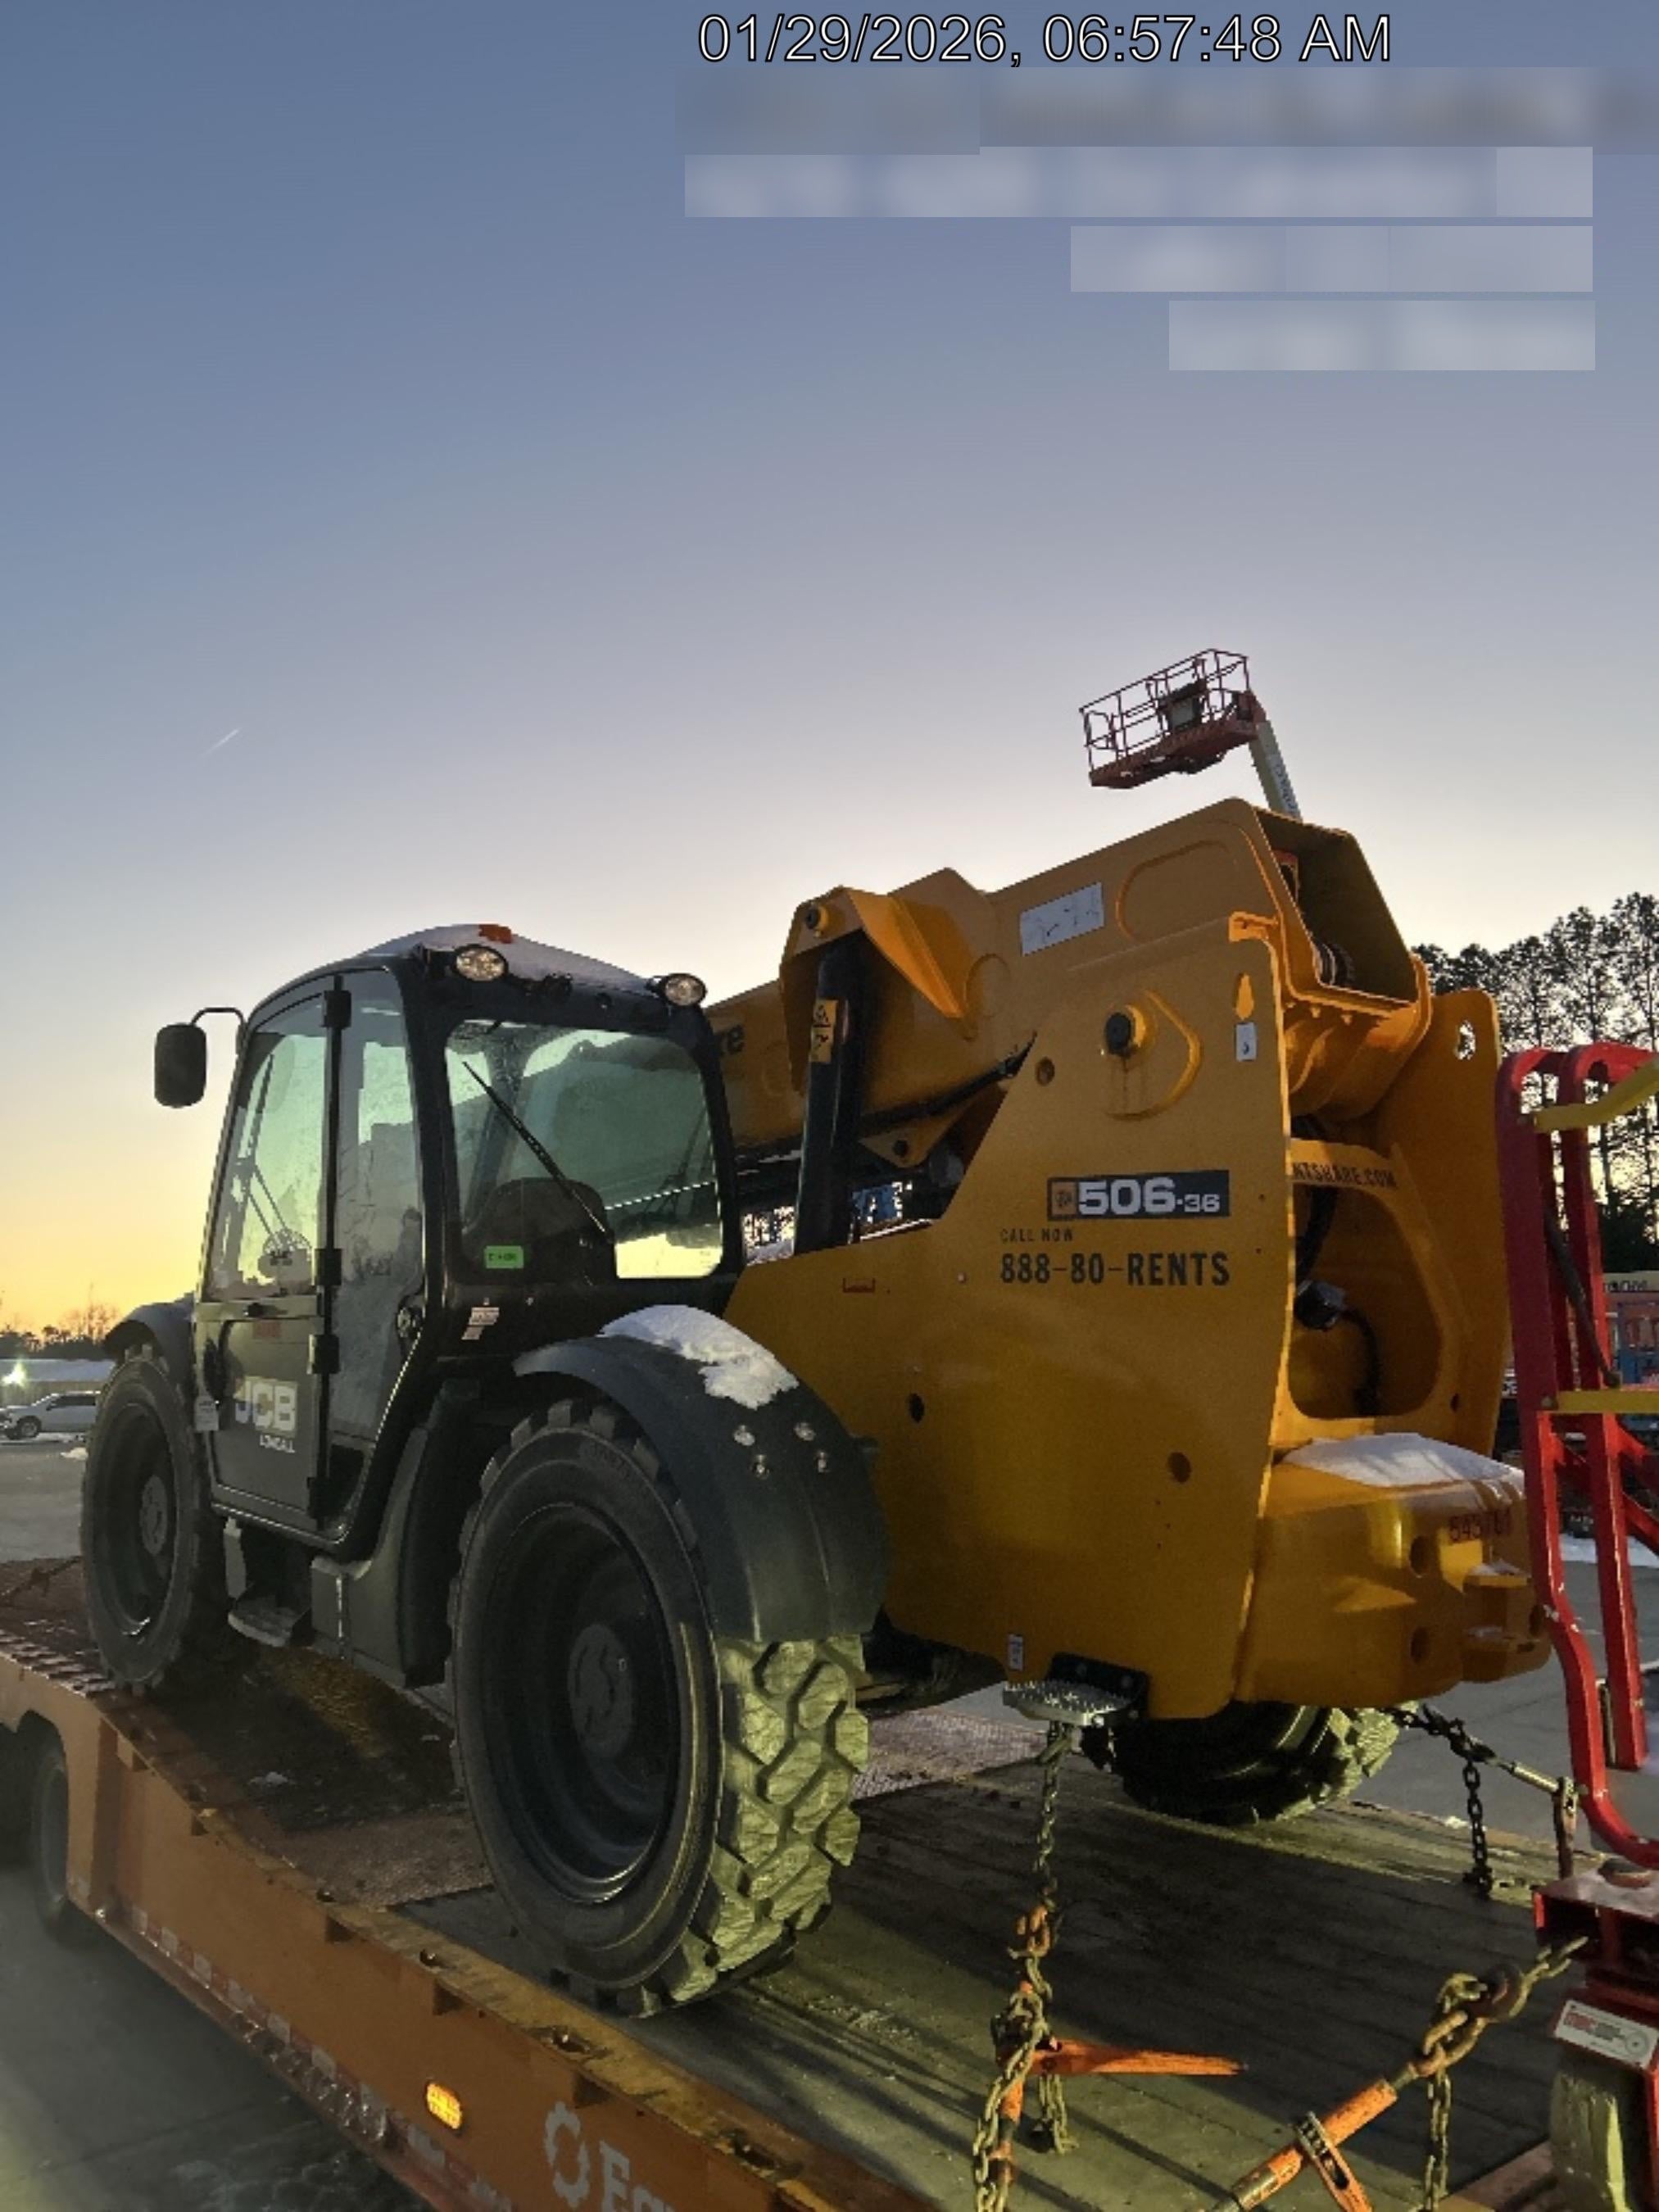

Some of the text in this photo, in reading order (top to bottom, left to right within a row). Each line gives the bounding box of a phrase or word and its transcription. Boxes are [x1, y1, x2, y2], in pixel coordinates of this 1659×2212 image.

[1000, 1228, 1074, 1243] CALL NOW
[1000, 1251, 1231, 1287] 888-80-RENTS
